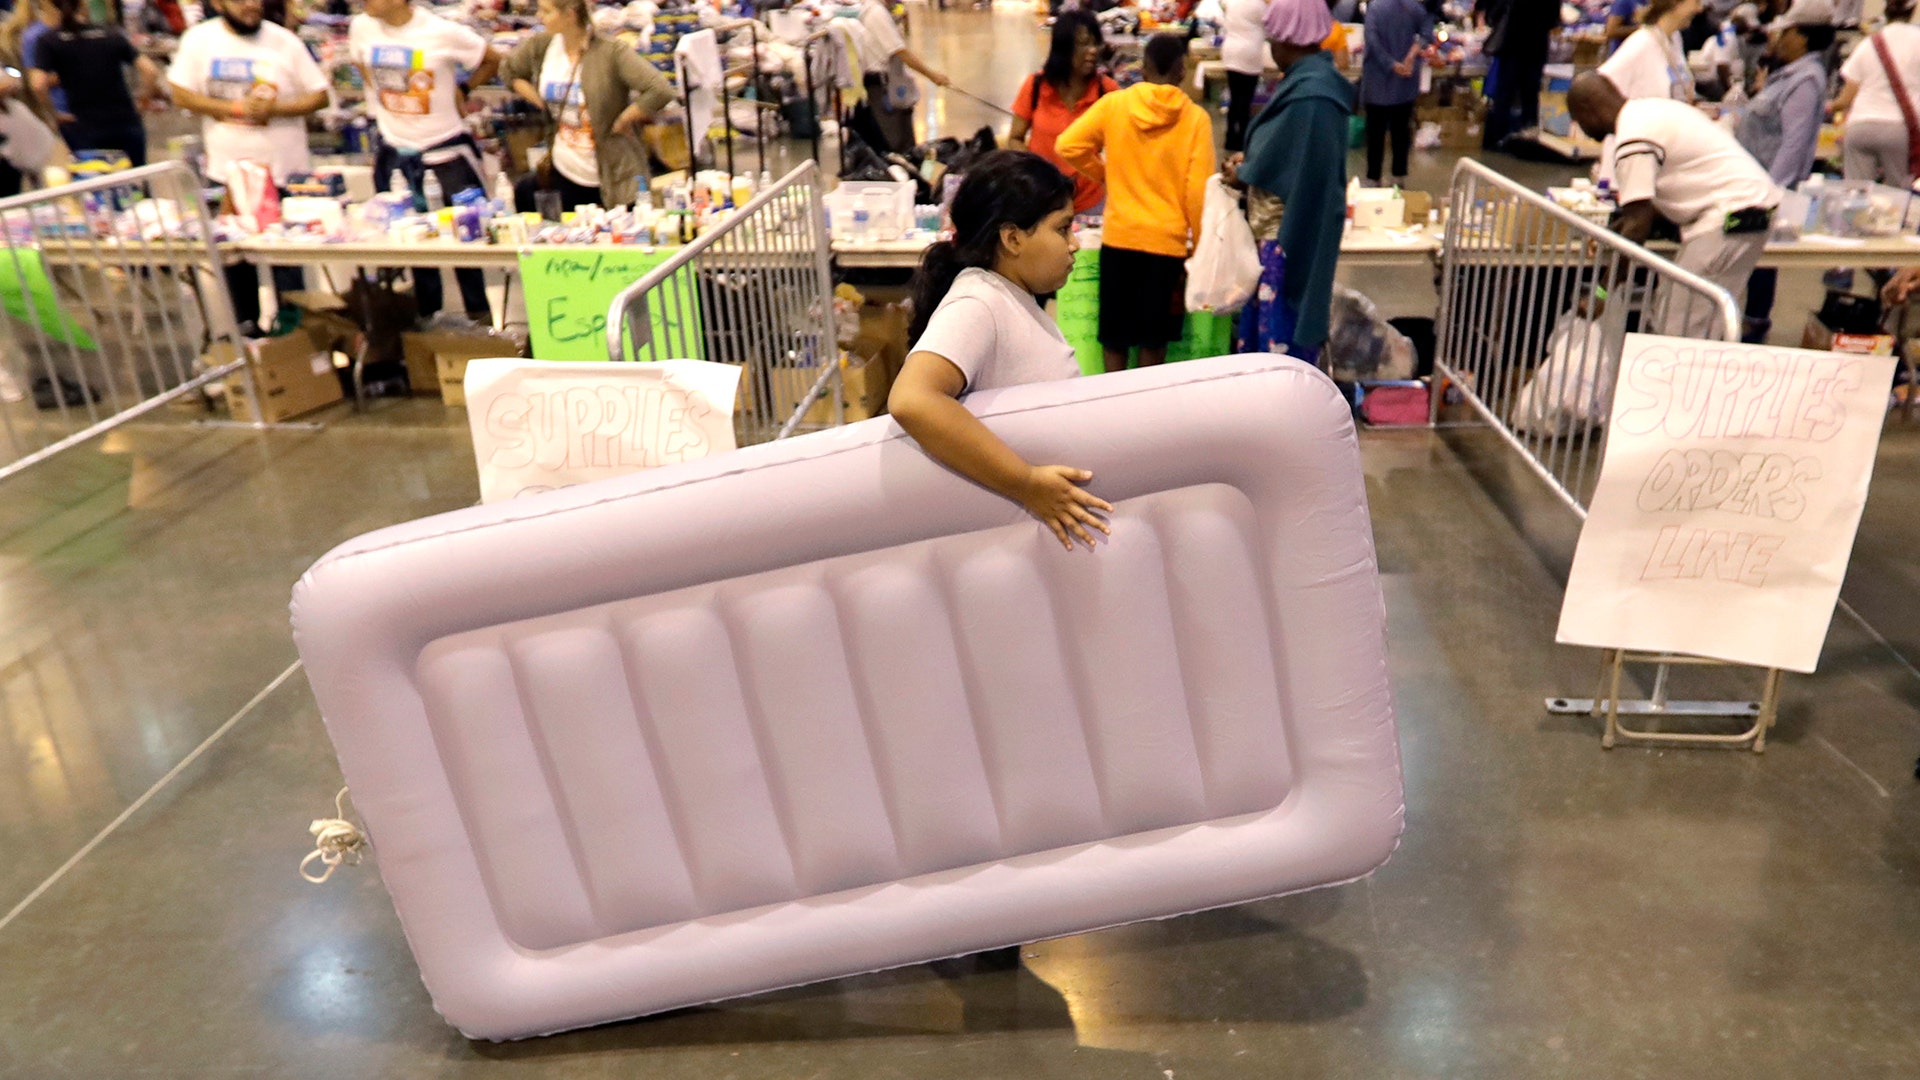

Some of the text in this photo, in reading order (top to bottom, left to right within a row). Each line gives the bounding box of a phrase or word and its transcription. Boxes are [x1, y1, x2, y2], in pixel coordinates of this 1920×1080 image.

[485, 384, 712, 471] SUPPLIES
[1616, 344, 1864, 443] SUPPLIES
[1637, 448, 1823, 522] ORDERS
[1640, 524, 1786, 588] LINE
